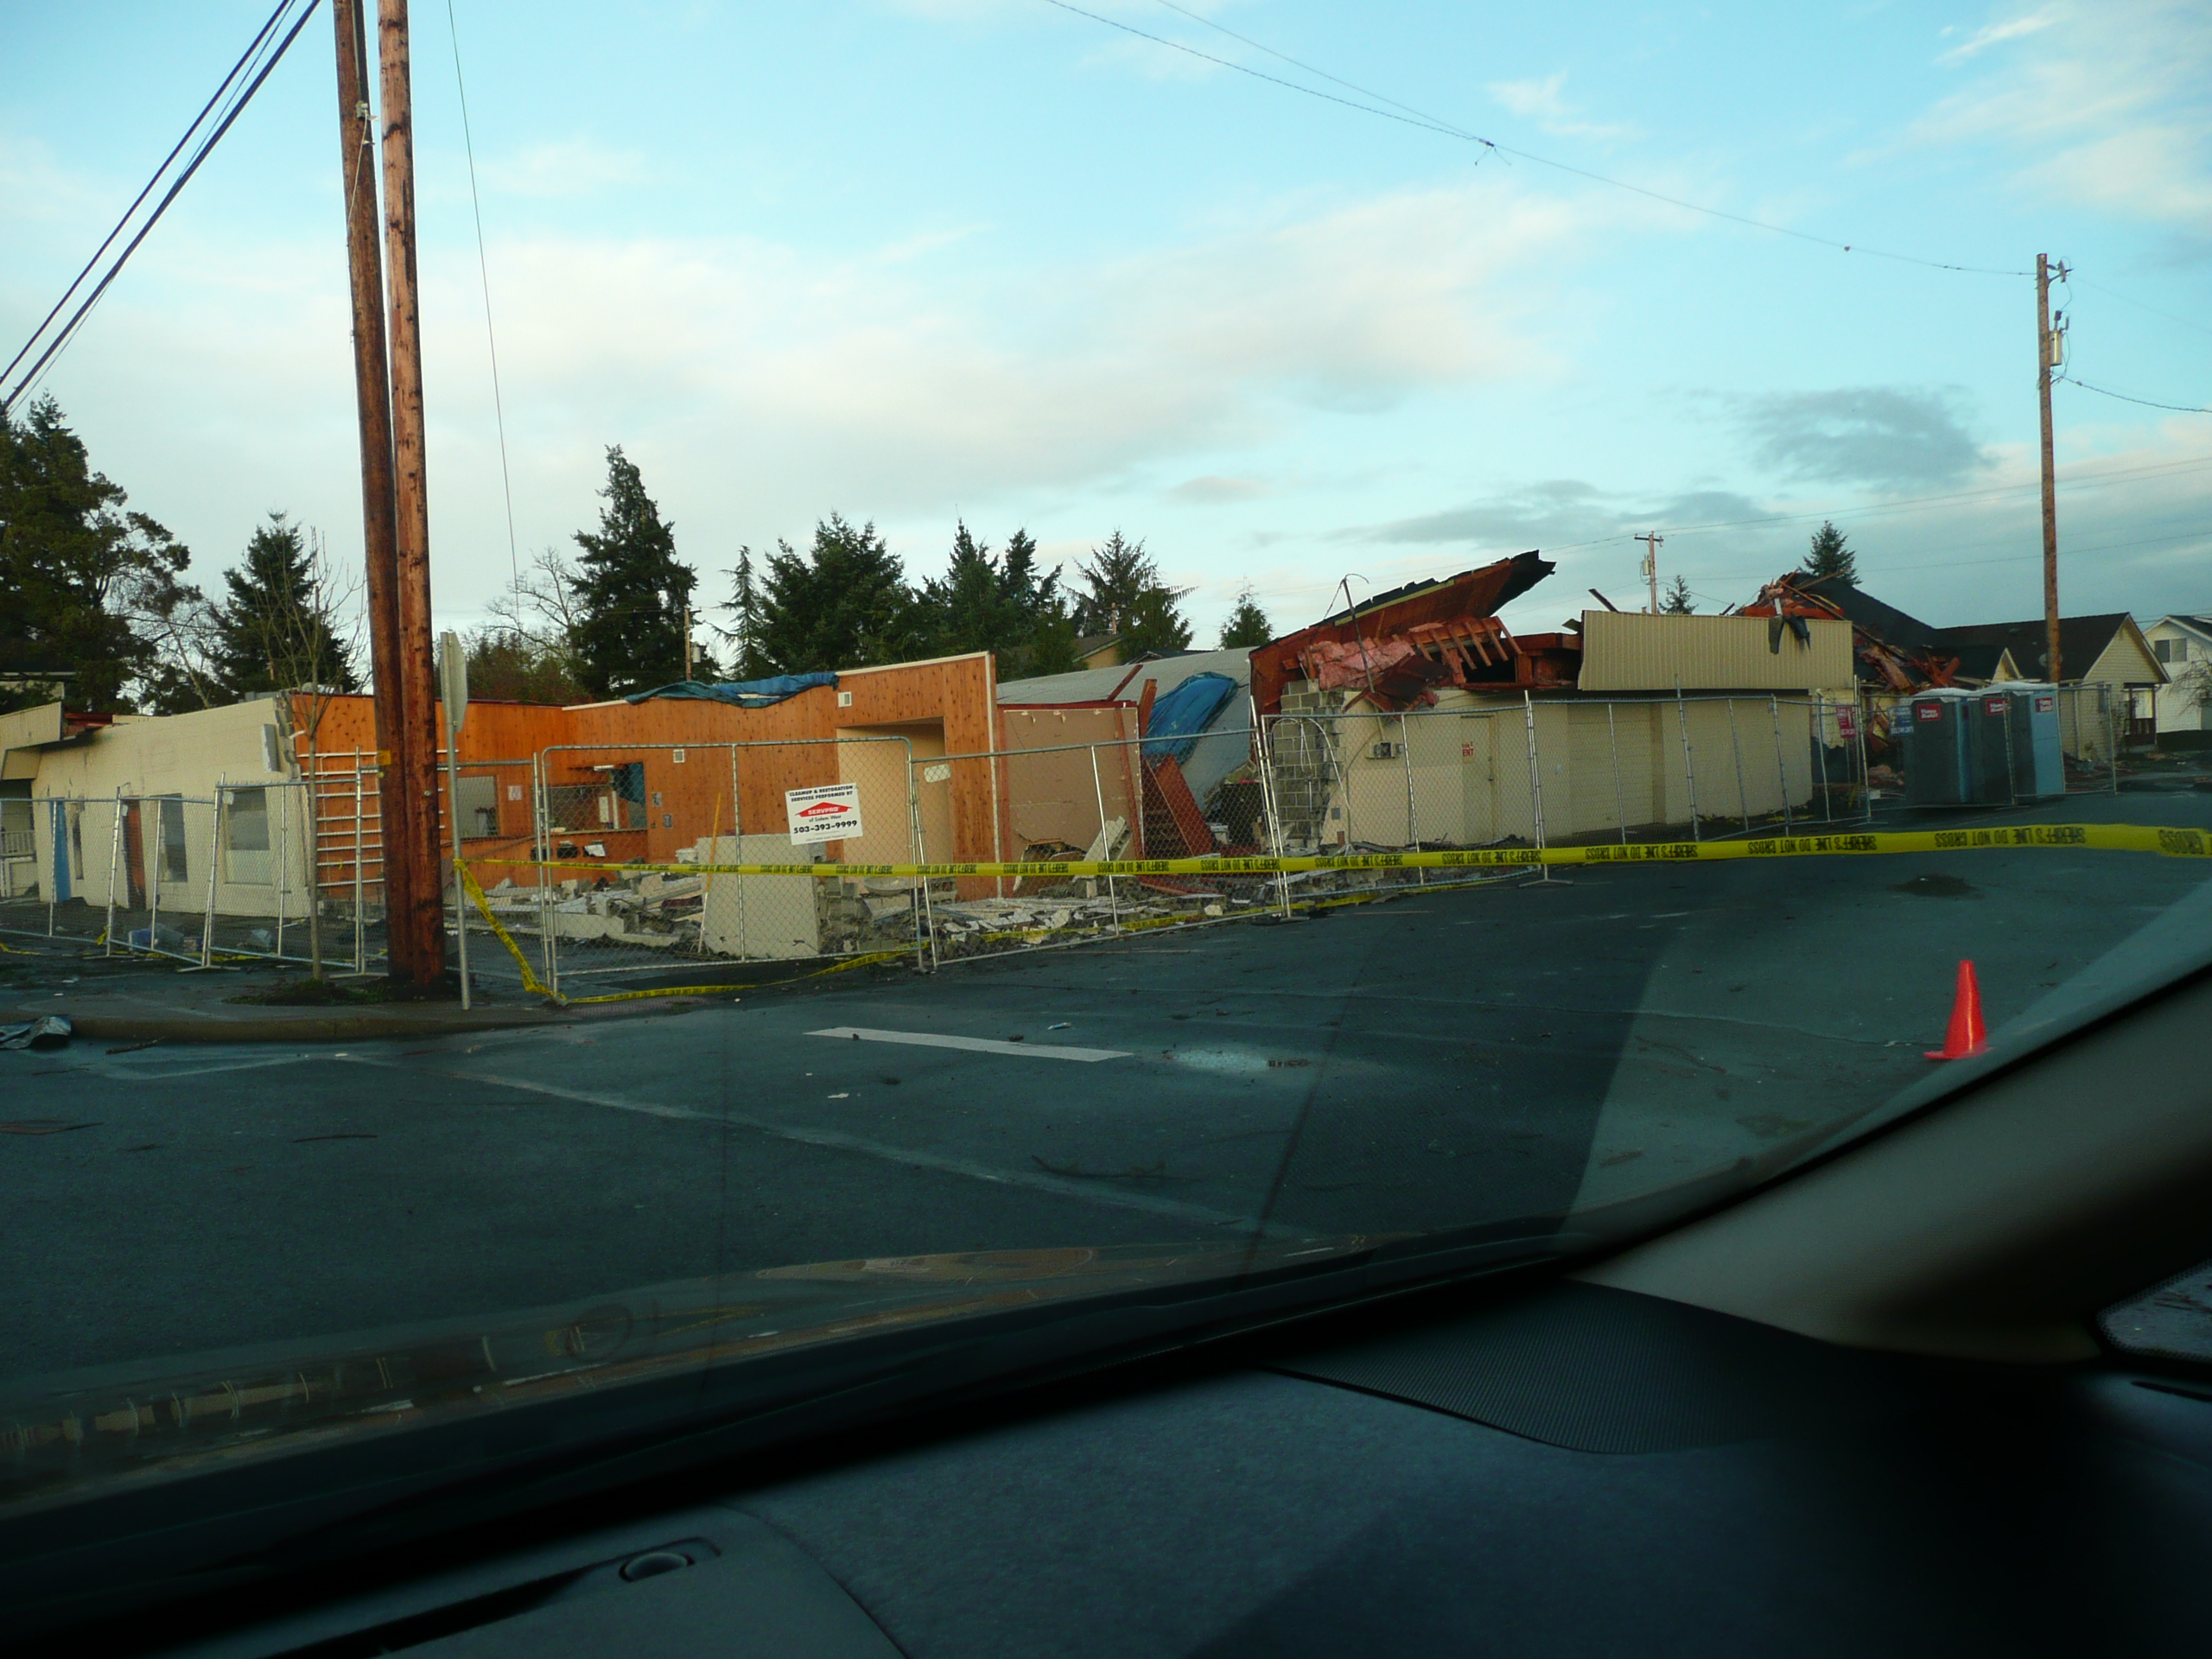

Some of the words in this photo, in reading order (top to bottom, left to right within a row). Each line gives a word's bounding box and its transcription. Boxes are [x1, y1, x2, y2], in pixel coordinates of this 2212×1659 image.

[815, 791, 845, 800] PERFORMED
[818, 785, 854, 793] RESTORATION
[808, 806, 839, 816] SERVPRO
[793, 820, 858, 835] 503-393-9999
[1935, 832, 1968, 848] CROSS
[1972, 830, 1992, 846] NOT
[1994, 829, 2009, 844] DO
[2013, 827, 2034, 844] LINE
[2036, 827, 2087, 845] SHERIFF'S
[1748, 840, 1777, 855] CROSS
[1780, 839, 1796, 854] NOT
[1799, 838, 1811, 852] DO
[1815, 837, 1833, 851] LINE
[1834, 836, 1878, 851] SHERIFF'S
[1481, 851, 1491, 864] DO
[1493, 851, 1508, 864] LINE
[1509, 850, 1541, 863] SHERIFF'S
[1585, 848, 1611, 860] CROSS
[1613, 847, 1628, 860] NOT
[1630, 846, 1641, 859] DO
[1644, 846, 1659, 859] LINE
[1661, 844, 1699, 858] SHERIFF'S
[1232, 859, 1240, 870] DO
[1243, 859, 1254, 870] LINE
[1254, 859, 1281, 870] SHERIFF'S
[1314, 857, 1336, 868] CROSS
[1338, 857, 1349, 868] NOT
[1349, 856, 1359, 868] DO
[1360, 855, 1375, 867] LINE
[1375, 855, 1403, 867] SHERIFF'S
[1441, 853, 1465, 866] CROSS
[1467, 852, 1480, 865] NOT
[1200, 860, 1219, 871] CROSS
[1221, 860, 1231, 871] NOT
